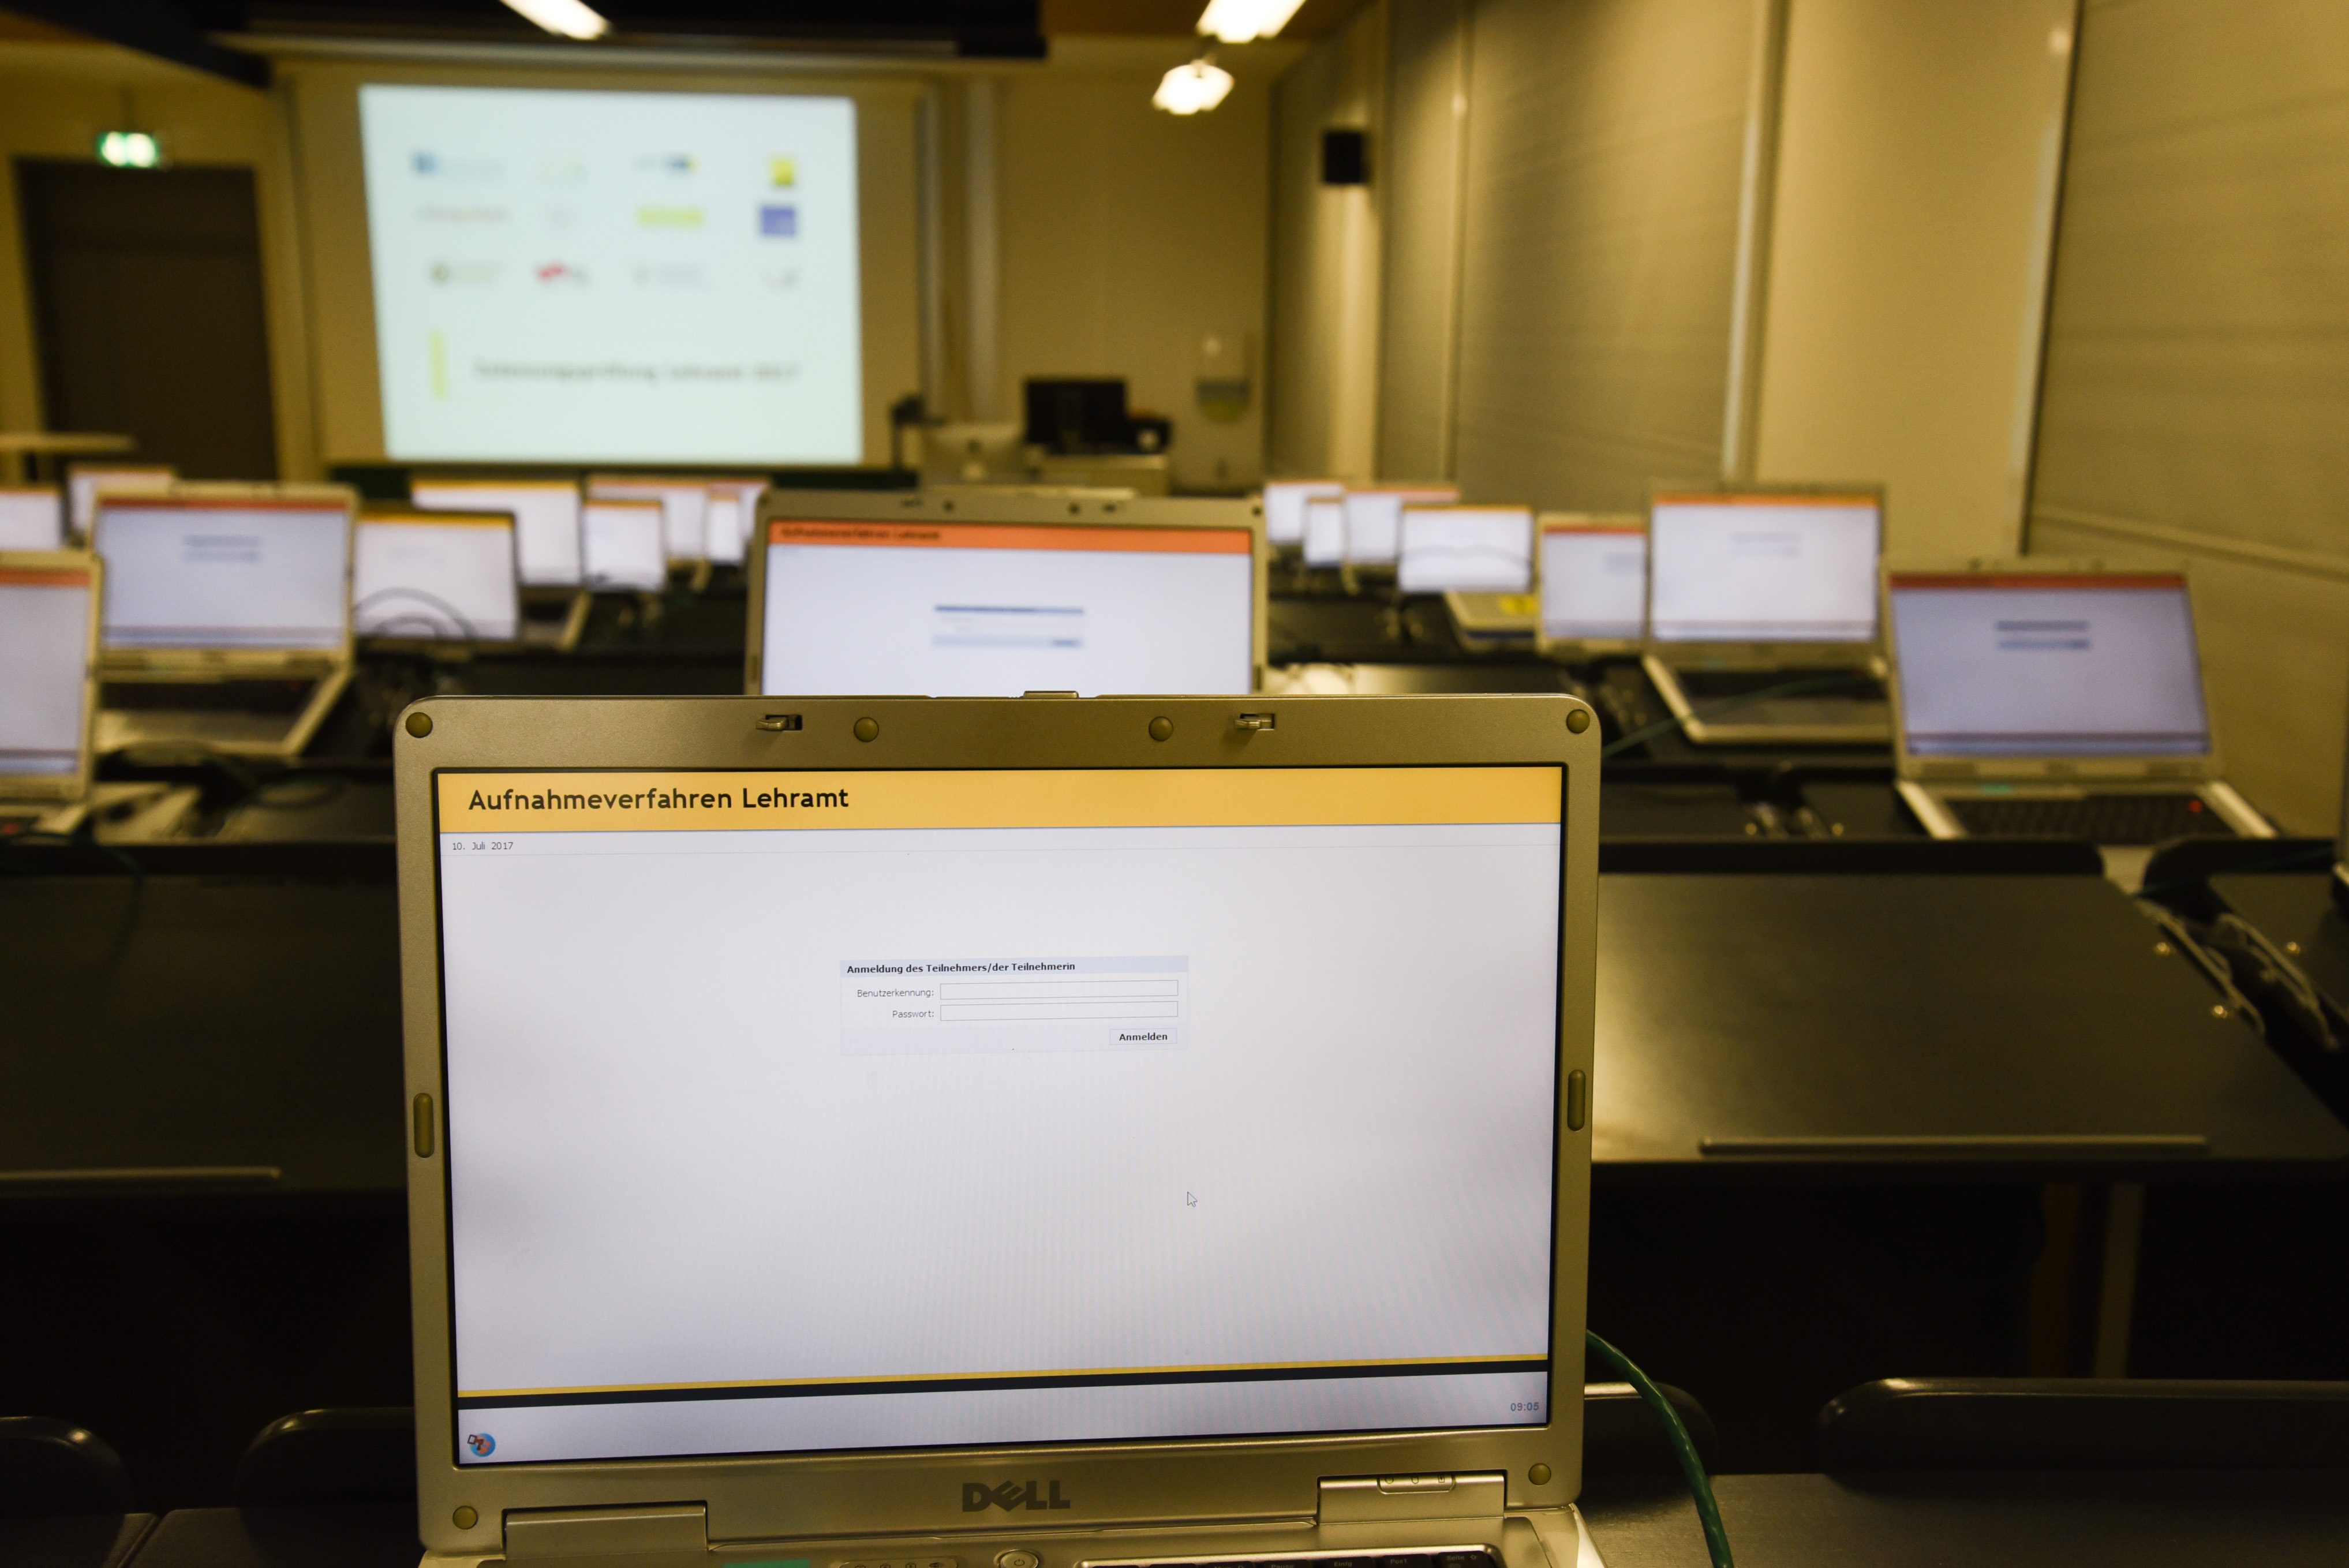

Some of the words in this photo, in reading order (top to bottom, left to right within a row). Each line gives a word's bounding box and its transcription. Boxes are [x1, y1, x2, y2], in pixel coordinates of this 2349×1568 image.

[469, 788, 732, 810] Aufnahmeverfahren
[743, 788, 849, 808] Lehramt
[452, 842, 465, 850] 10.
[472, 841, 485, 850] Juli
[491, 842, 514, 850] 2017
[847, 965, 903, 974] Anmeldung
[906, 964, 923, 972] des
[926, 963, 1009, 973] Teilnehmers/der
[1011, 963, 1075, 971] Teilnehmerin
[857, 989, 934, 998] Benutzerkennung:
[1119, 1032, 1168, 1041] Anmelden
[1510, 1402, 1539, 1411] 09:05
[962, 1480, 1071, 1512] DELL
